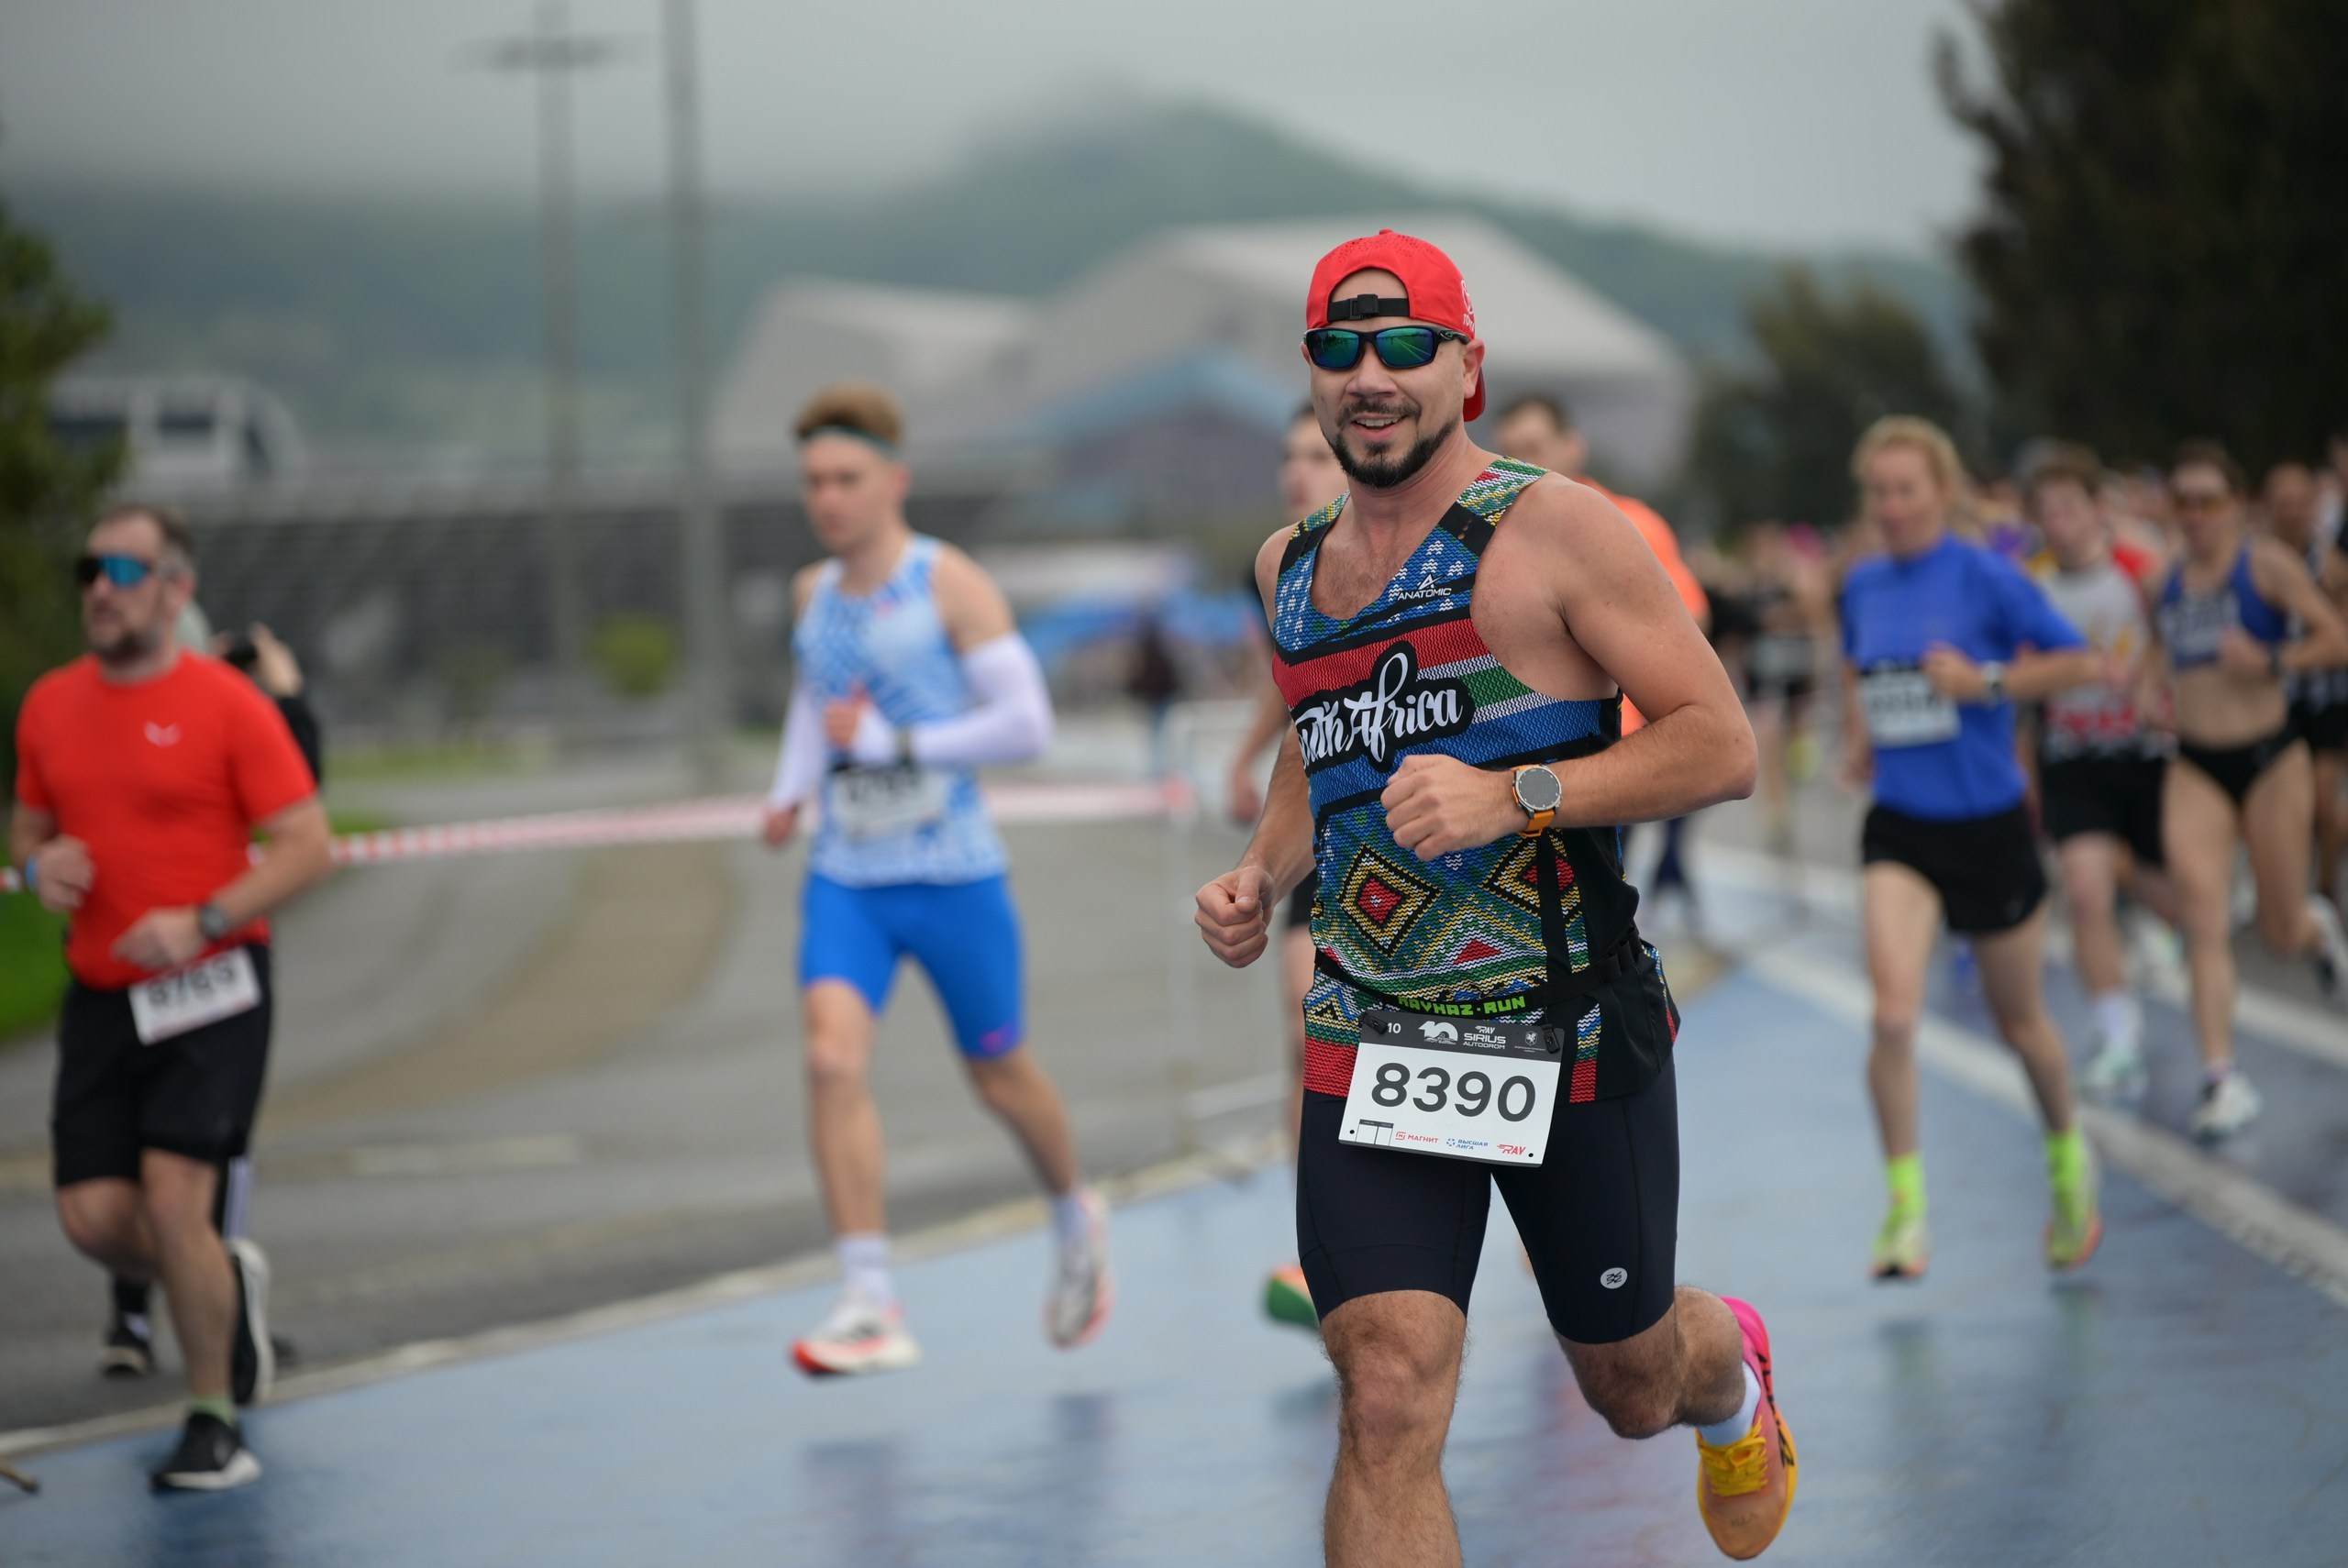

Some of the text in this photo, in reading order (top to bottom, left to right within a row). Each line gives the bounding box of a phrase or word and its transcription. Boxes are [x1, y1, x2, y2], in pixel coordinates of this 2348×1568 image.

[1397, 587, 1452, 601] ANATOMIC
[1344, 652, 1463, 762] Africa
[1483, 996, 1526, 1014] RUN
[1387, 1022, 1401, 1033] 10
[1475, 1025, 1496, 1034] RAY
[1463, 1032, 1506, 1044] SIRIUS
[1463, 1041, 1506, 1050] AUTODROM
[1371, 1062, 1536, 1122] 8390
[1407, 1133, 1439, 1143] МАГНИТ
[1457, 1139, 1489, 1147] ВЫСШАЯ
[1497, 1143, 1526, 1155] RAY
